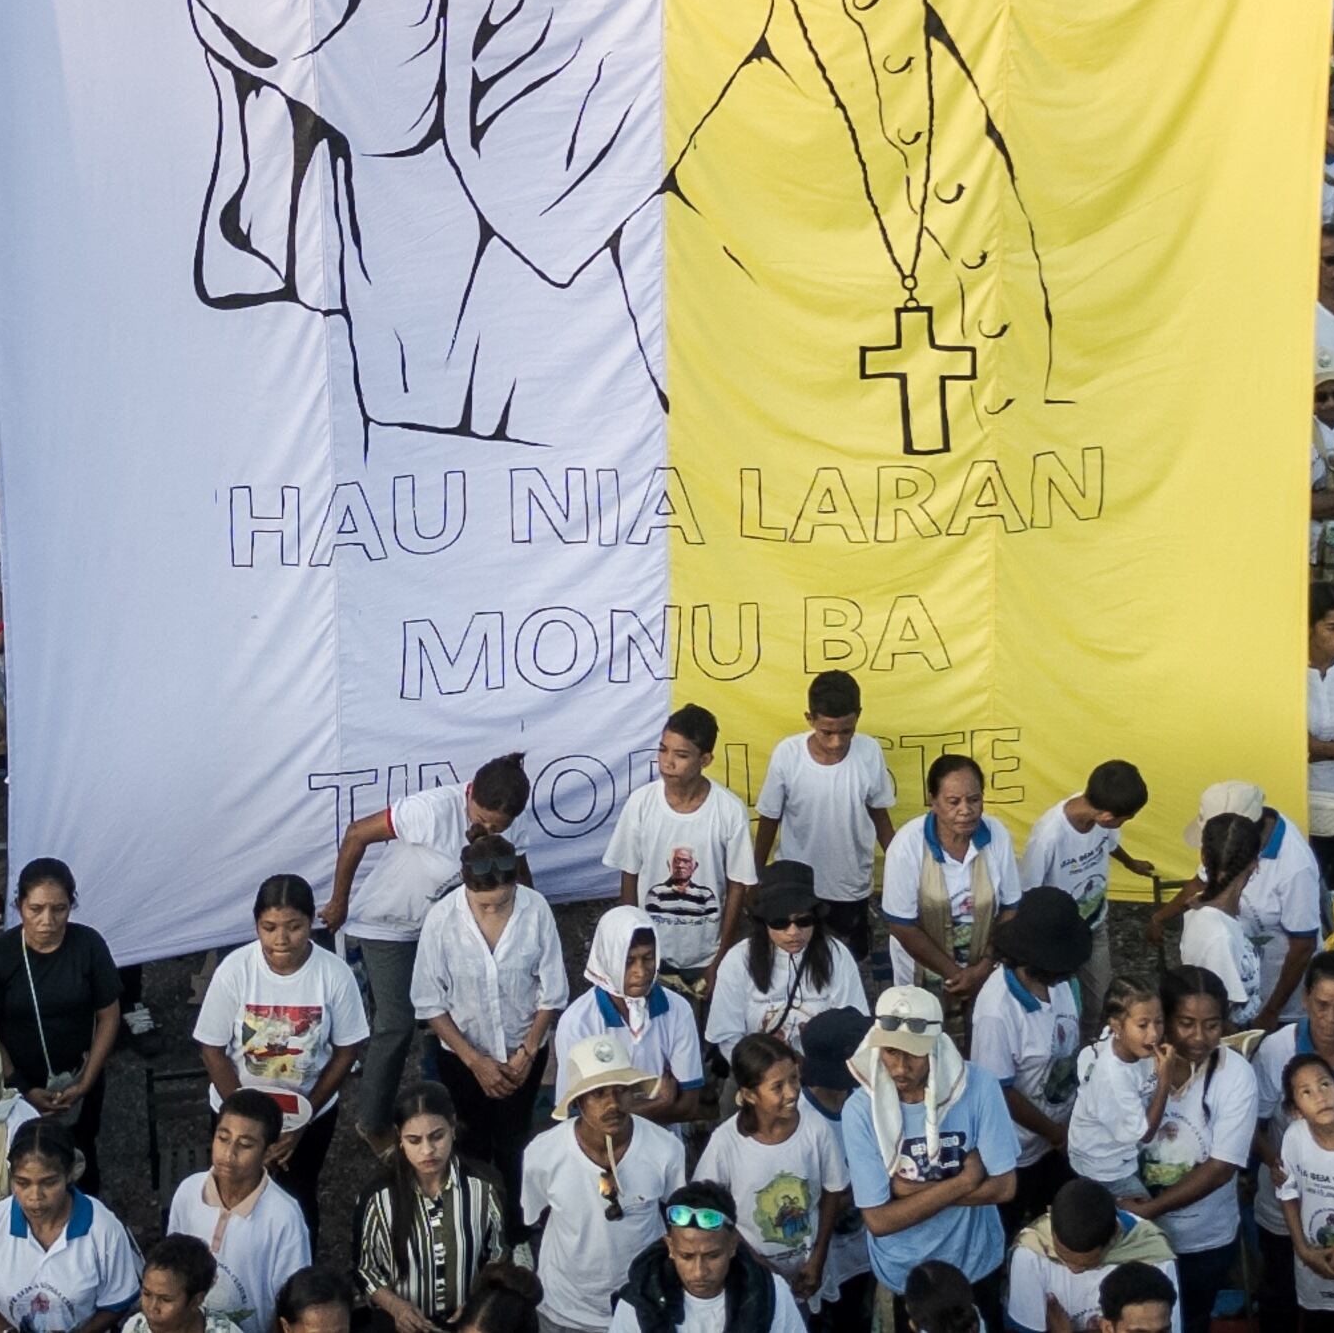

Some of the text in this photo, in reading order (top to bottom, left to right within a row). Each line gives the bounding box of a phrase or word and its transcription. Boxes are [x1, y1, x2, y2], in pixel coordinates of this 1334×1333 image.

[230, 446, 1104, 568] HAU NIA LARAN
[400, 594, 953, 701] MONU BA
